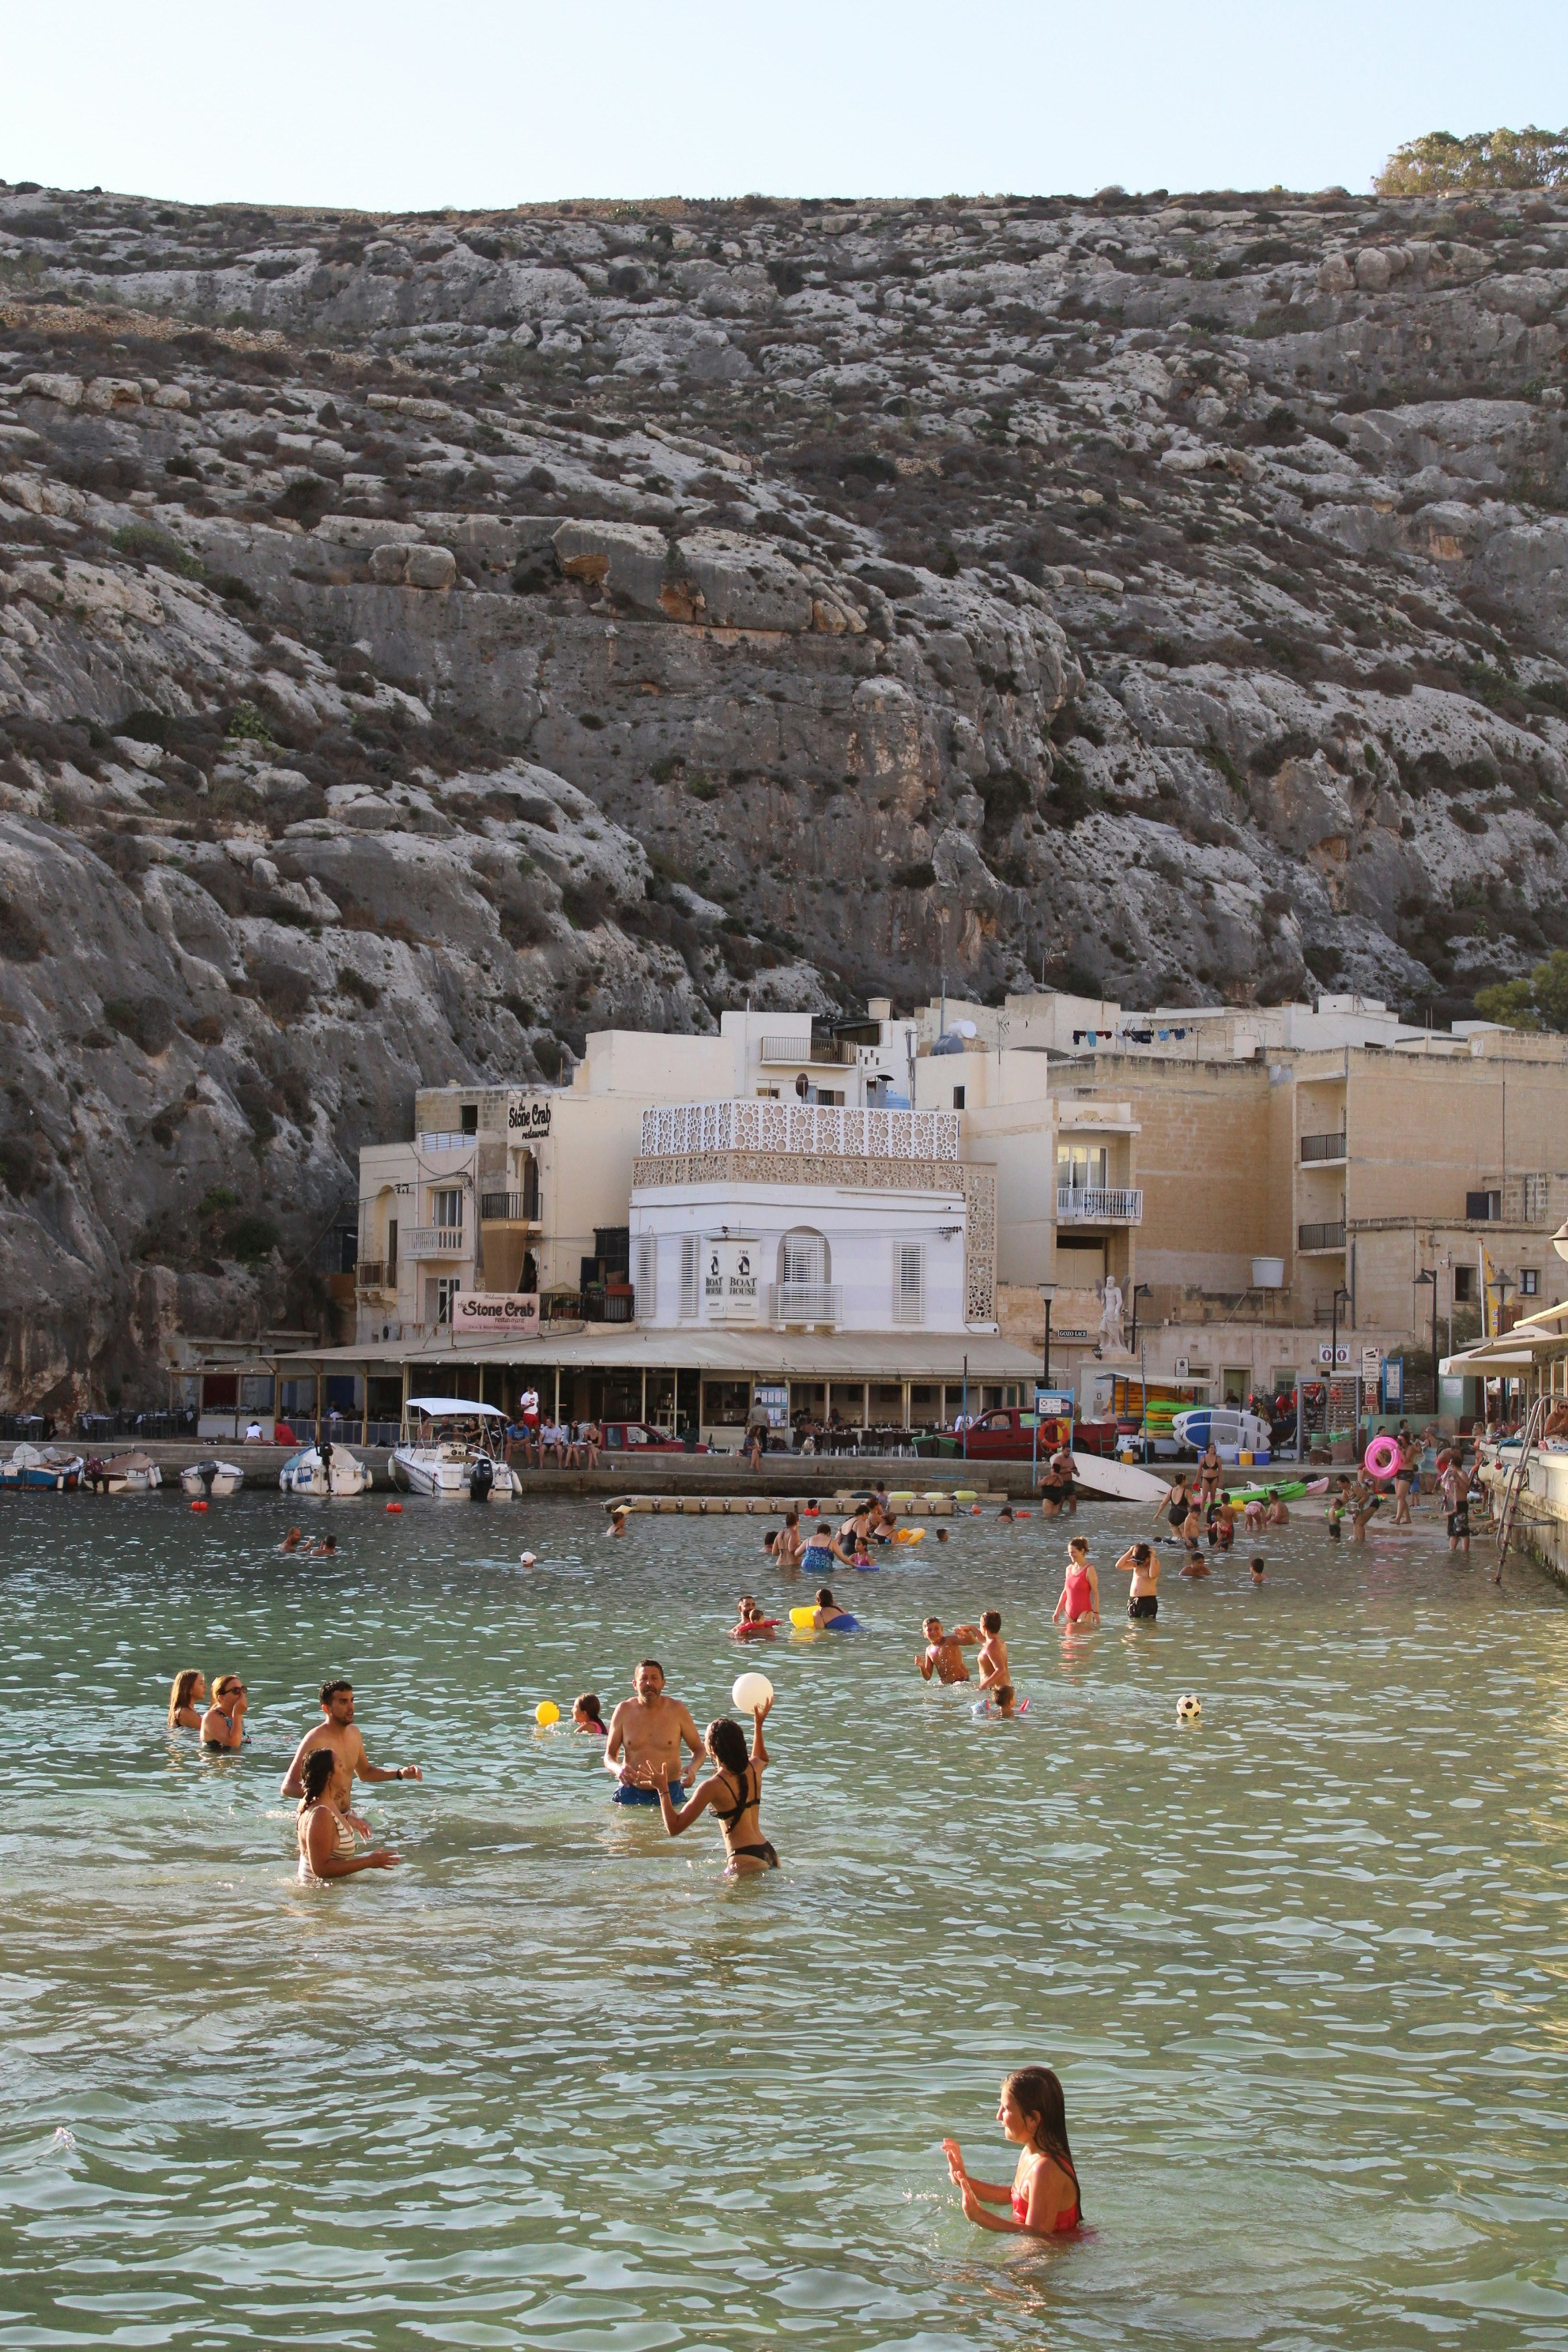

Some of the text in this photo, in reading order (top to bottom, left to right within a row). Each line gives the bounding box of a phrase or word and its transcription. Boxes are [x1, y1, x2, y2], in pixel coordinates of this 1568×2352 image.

[509, 1102, 551, 1128] Stone Crab
[522, 1124, 550, 1140] restaurant
[706, 1277, 722, 1287] BOAT
[730, 1277, 757, 1287] BOAT
[462, 1301, 534, 1317] Stone Crab
